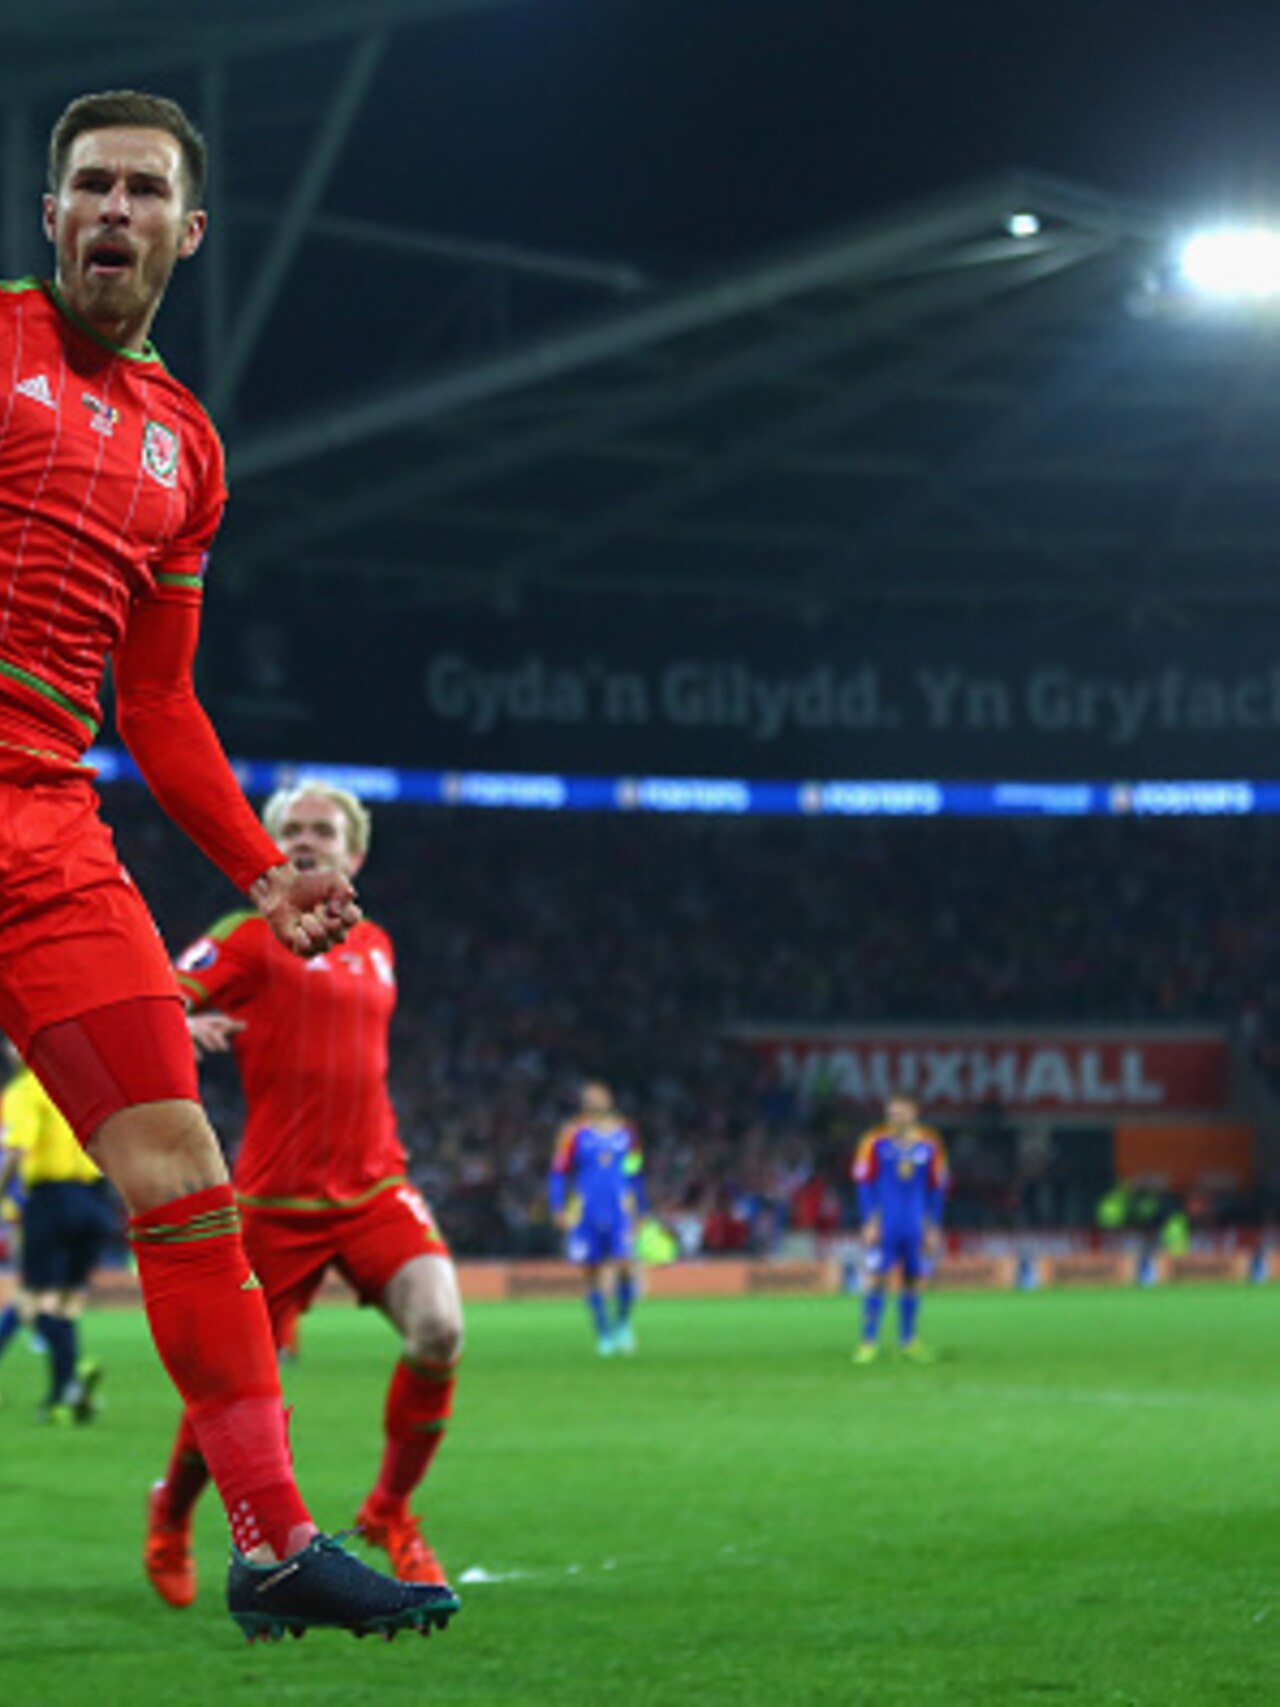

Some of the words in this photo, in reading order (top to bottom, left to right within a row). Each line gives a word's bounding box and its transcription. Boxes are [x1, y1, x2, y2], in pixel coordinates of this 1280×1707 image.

[428, 654, 646, 734] Gyda'n
[662, 662, 901, 740] Gilydd.
[917, 666, 1010, 728] Yn
[778, 1048, 1164, 1102] VAUXHALL
